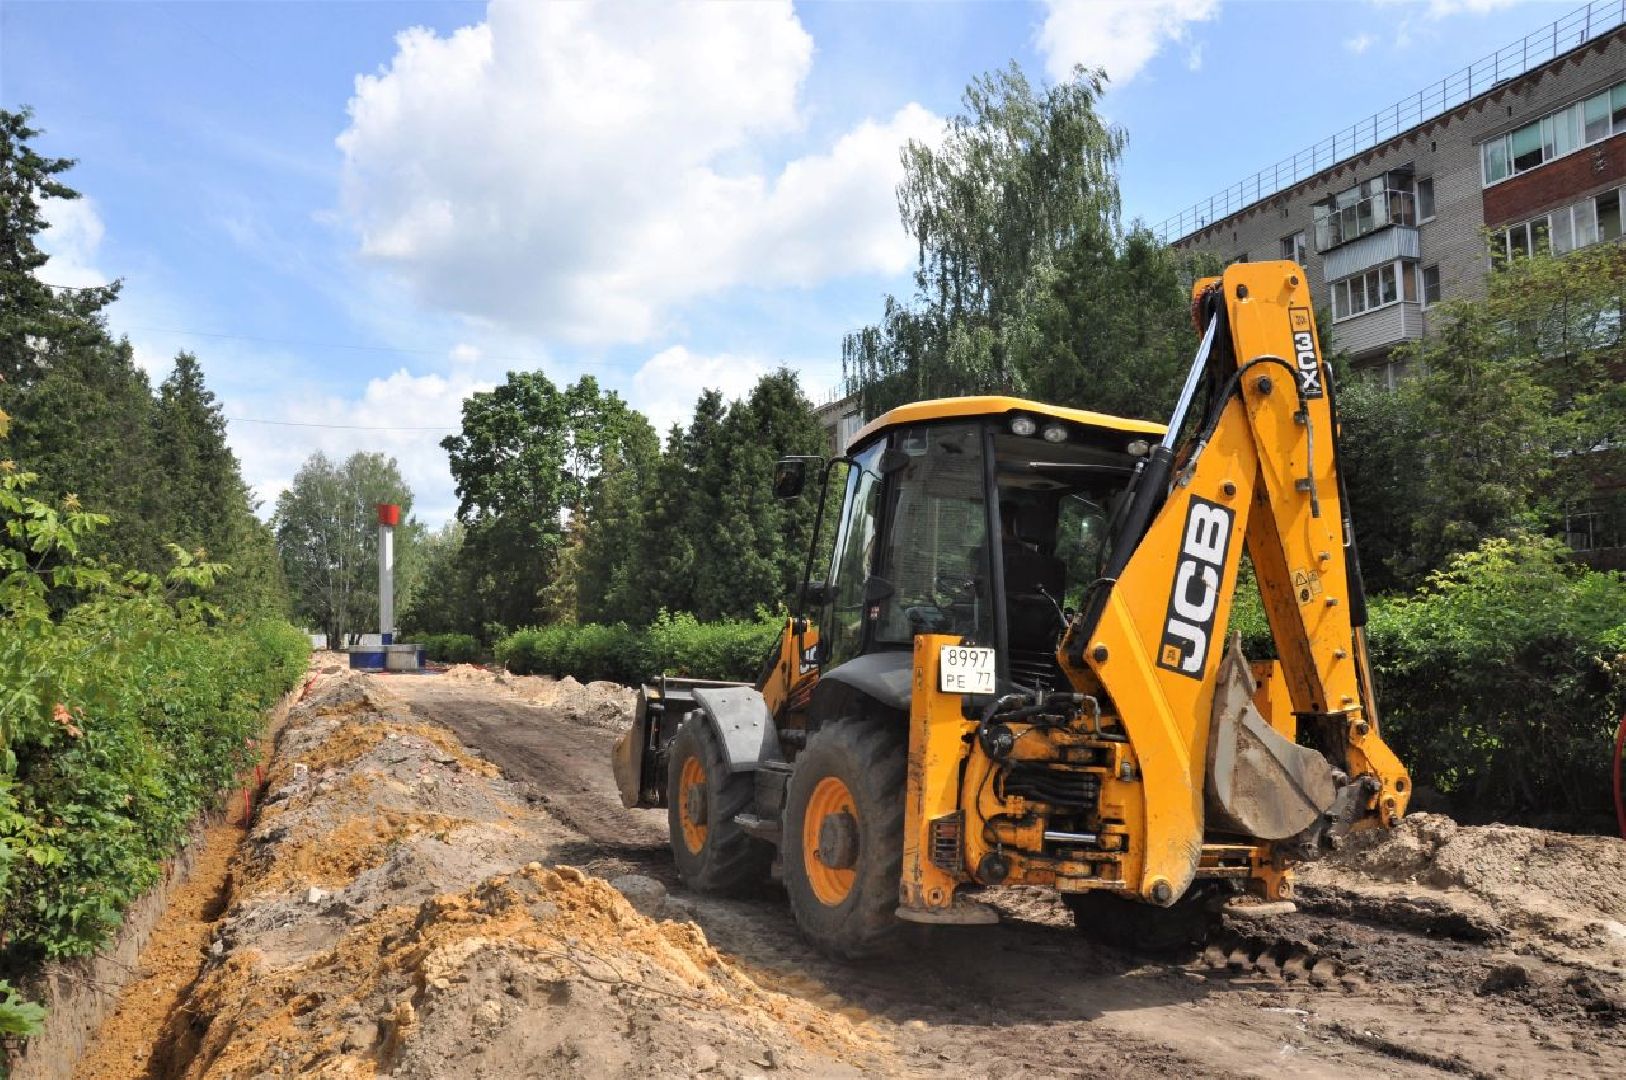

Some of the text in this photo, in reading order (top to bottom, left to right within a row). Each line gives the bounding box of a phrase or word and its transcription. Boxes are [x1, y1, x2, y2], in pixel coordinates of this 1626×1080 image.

[1294, 333, 1321, 388] 3CX
[1168, 503, 1230, 672] JCB
[948, 649, 988, 668] 8997
[976, 672, 991, 686] 77
